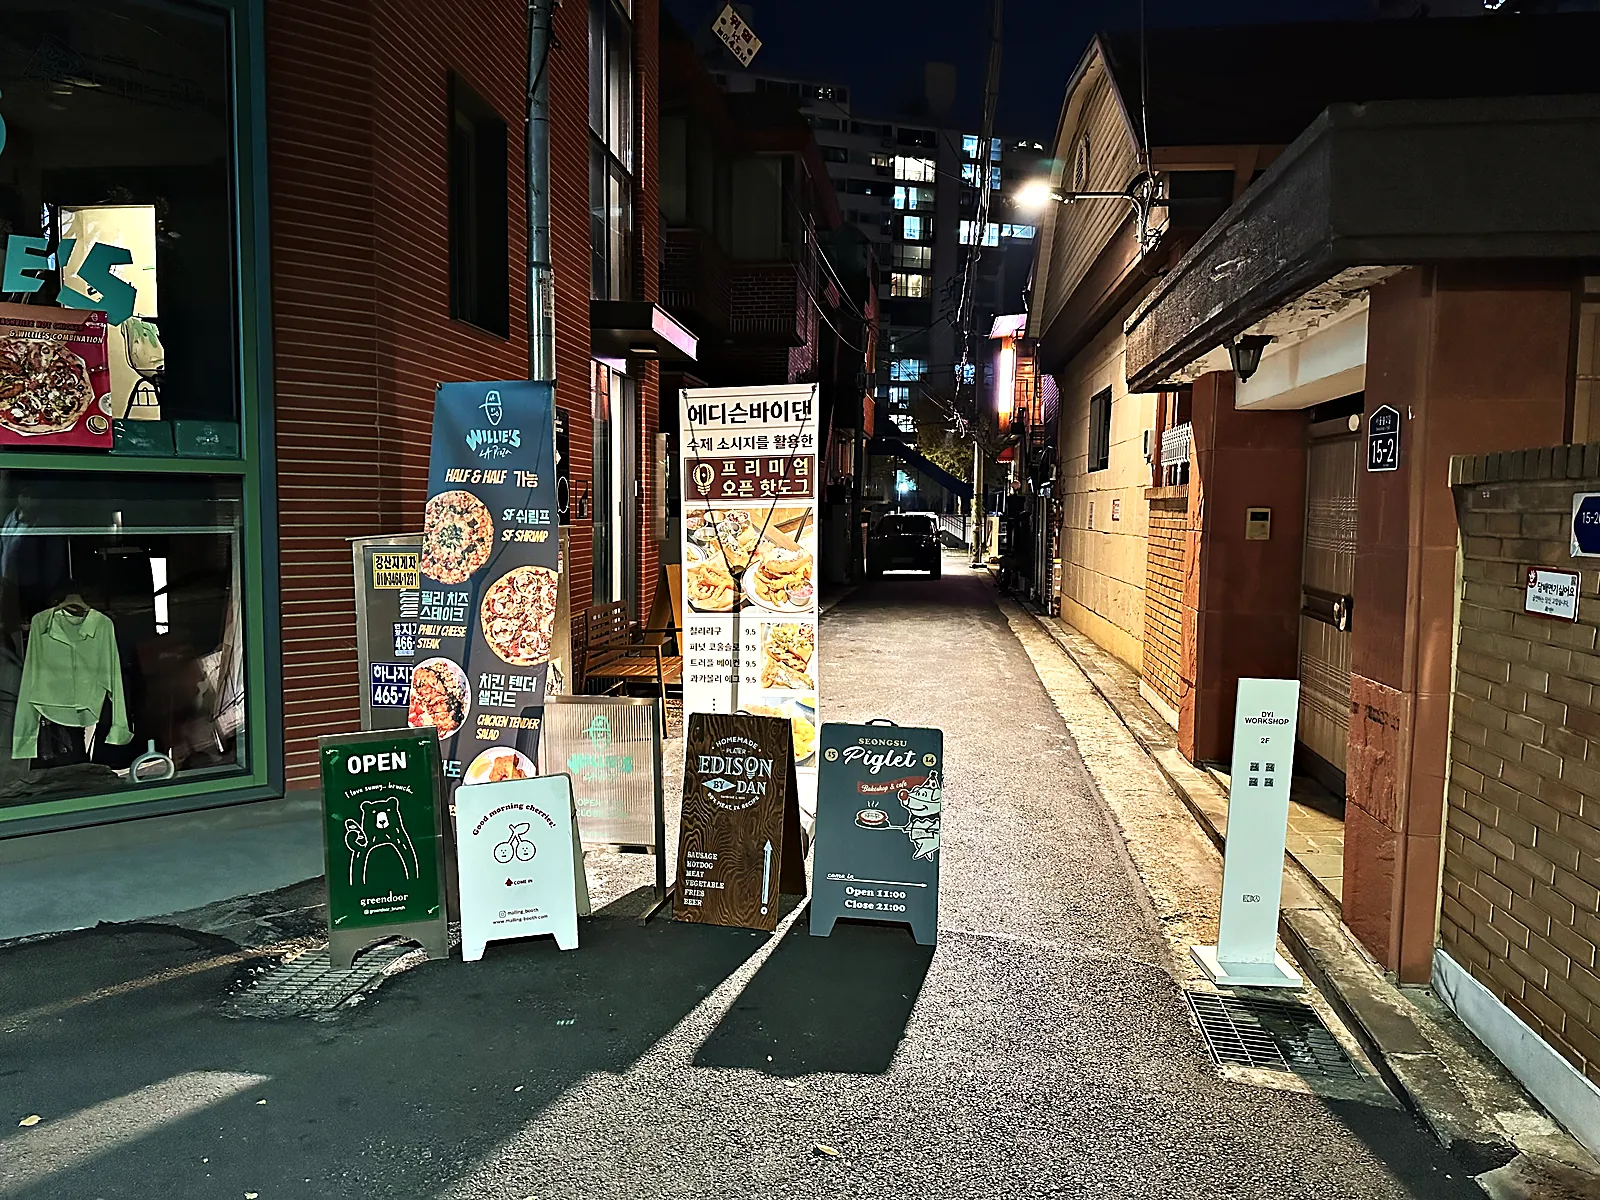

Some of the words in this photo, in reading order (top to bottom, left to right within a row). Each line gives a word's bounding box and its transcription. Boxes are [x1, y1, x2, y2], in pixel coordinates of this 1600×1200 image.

[52, 333, 103, 344] COMBINATION
[688, 400, 812, 425] 에디슨바이댄
[465, 429, 521, 452] WILLIE'S
[687, 437, 713, 451] 수제
[717, 436, 769, 450] 소시지를
[773, 434, 813, 449] 활용한
[1372, 438, 1394, 464] 15-2
[721, 458, 808, 477] 프리미엄
[445, 469, 471, 483] HALF
[472, 469, 482, 484] &
[482, 470, 508, 484] HALF
[514, 470, 538, 488] 가능
[721, 479, 754, 497] 오픈
[760, 479, 810, 497] 핫도그
[502, 509, 515, 521] SF
[515, 510, 550, 525] 쉬림프
[501, 530, 514, 542] SF
[514, 530, 548, 543] SHRIMP
[375, 555, 417, 570] 강산지게차
[421, 591, 444, 606] 필리
[447, 592, 469, 607] 치즈
[419, 607, 464, 621] 스테이크
[417, 623, 441, 636] PHILLY
[441, 625, 467, 637] CHEESE
[416, 638, 441, 649] STEAK
[479, 673, 504, 690] 치킨
[509, 675, 537, 692] 텐더
[478, 691, 516, 708] 샐러드
[476, 714, 508, 727] CHICKEN
[508, 716, 540, 730] TENDER
[1245, 717, 1290, 725] WORKSHOP
[475, 728, 499, 741] SALAD
[716, 736, 758, 750] HOMEMADE
[858, 738, 907, 747] SEONGSU
[347, 751, 407, 775] OPEN
[843, 745, 916, 774] Piglet
[698, 755, 773, 780] EDISON
[350, 788, 363, 797] love
[713, 781, 725, 789] BY
[736, 780, 767, 796] DAN
[472, 815, 490, 836] Good
[489, 803, 524, 818] morning
[525, 804, 557, 829] cherries!
[687, 851, 718, 860] SAUSAGE
[686, 861, 714, 869] HOTDOG
[686, 870, 704, 878] MEAT
[685, 880, 725, 889] VEGETABLE
[360, 891, 409, 907] greendoor
[684, 889, 705, 897] FRIES
[846, 886, 874, 897] Open
[876, 889, 906, 899] 11:00
[683, 898, 702, 906] BEER
[844, 900, 874, 910] Close
[876, 902, 906, 912] 21:00
